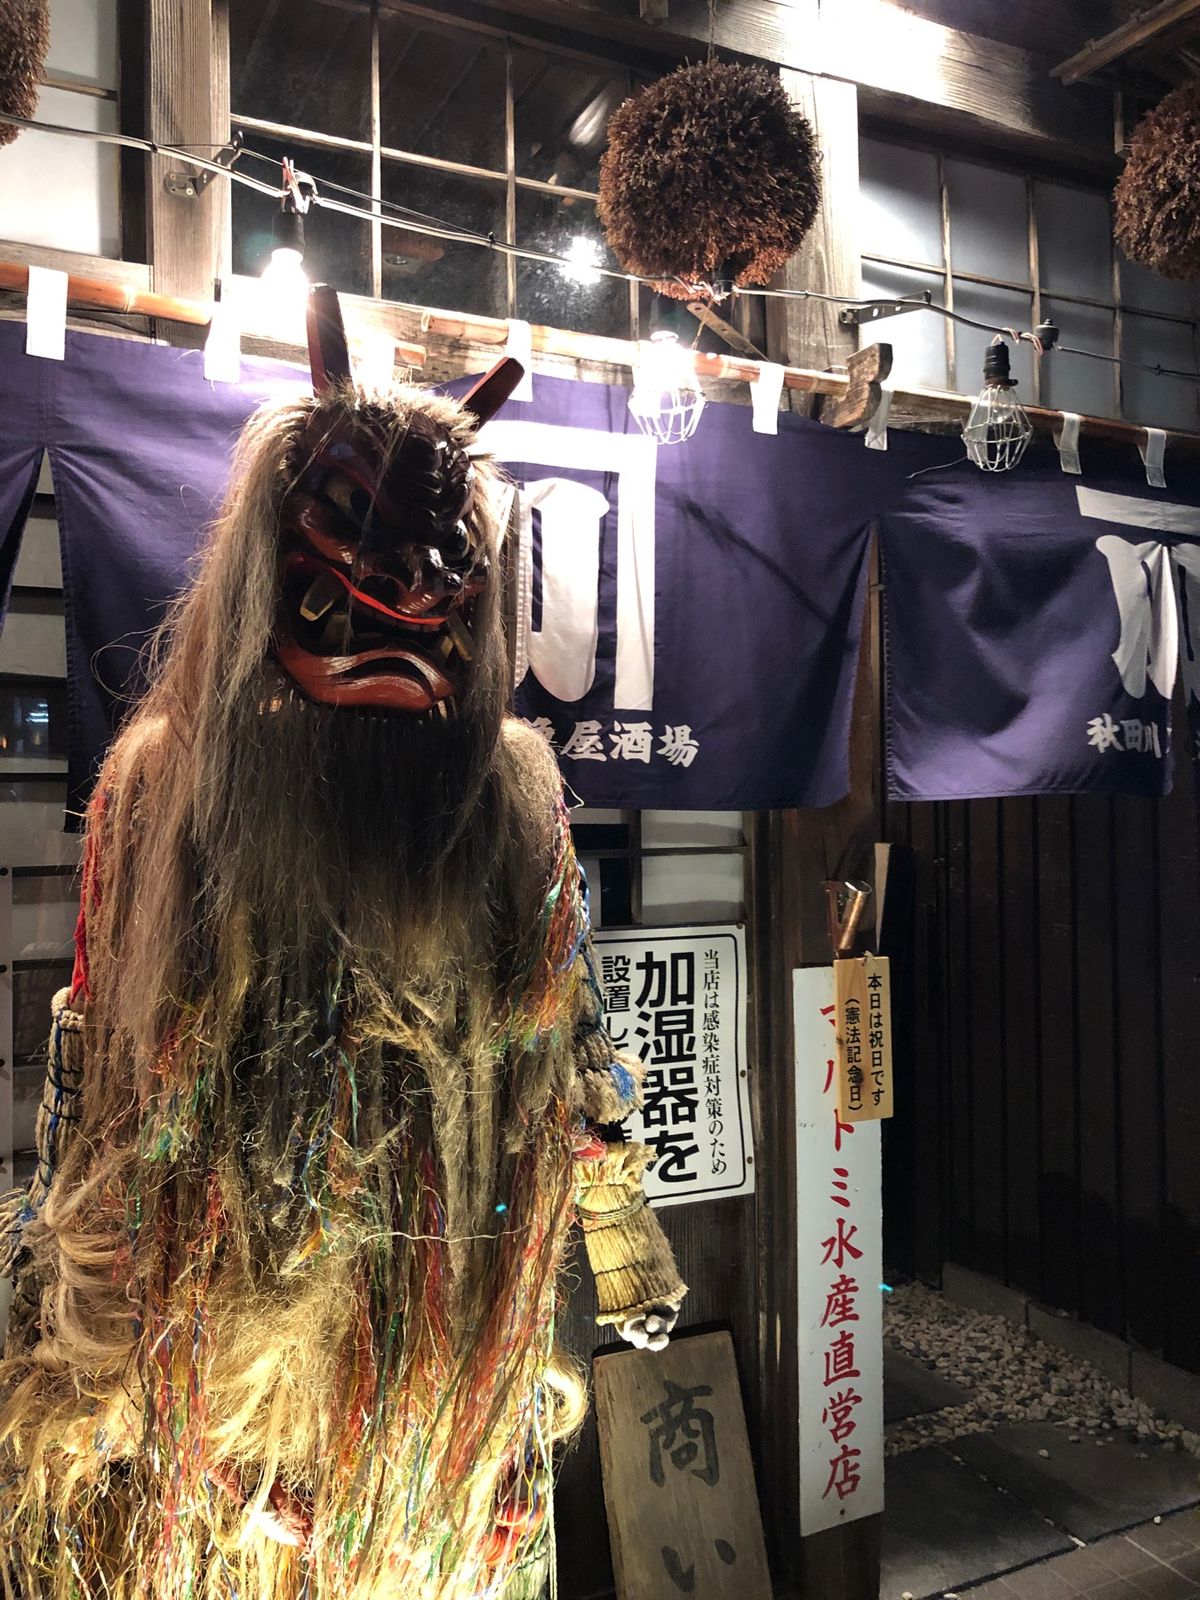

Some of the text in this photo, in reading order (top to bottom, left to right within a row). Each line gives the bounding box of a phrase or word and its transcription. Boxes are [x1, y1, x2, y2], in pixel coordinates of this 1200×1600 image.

[634, 951, 699, 1183] 加湿器を
[702, 949, 727, 1176] 当店は感染症対策のため
[845, 998, 863, 1111] （憲法記念日）
[867, 973, 885, 1106] 本日は祝日です
[640, 1379, 736, 1593] 商い
